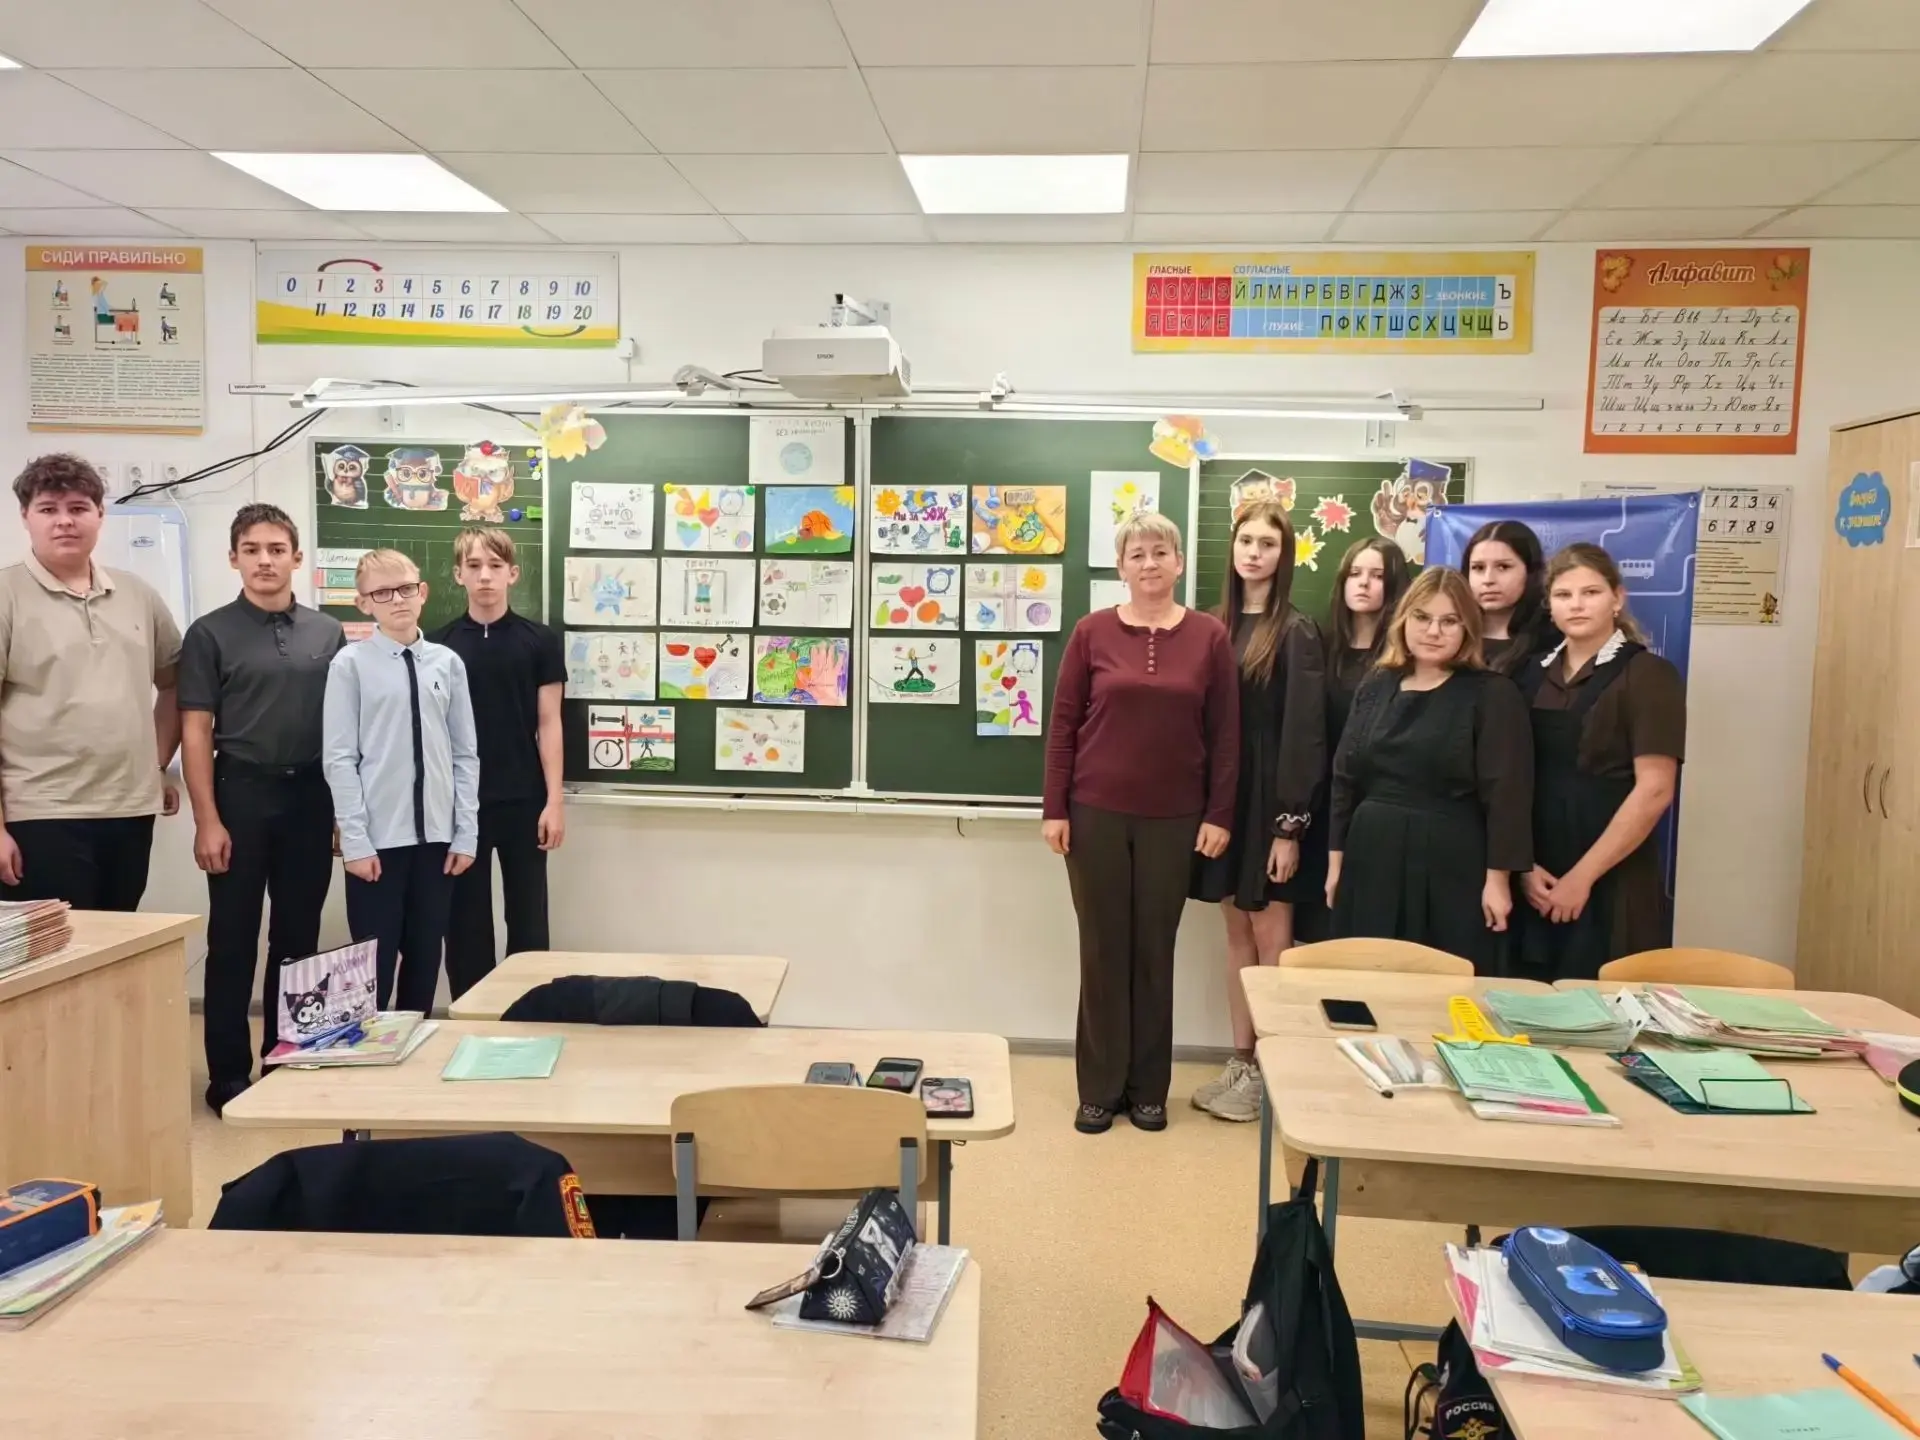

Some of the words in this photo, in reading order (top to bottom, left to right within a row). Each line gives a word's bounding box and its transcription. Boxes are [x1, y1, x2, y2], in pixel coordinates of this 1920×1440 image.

[41, 250, 84, 266] СИДИ
[88, 251, 187, 266] ПРАВИЛЬНО
[1149, 265, 1192, 274] ГЛАСНЫЕ
[1233, 265, 1291, 275] СОГЛАСНЫЕ
[1648, 260, 1755, 288] Алфавит
[286, 278, 297, 292] 0
[317, 279, 323, 293] 1
[346, 279, 355, 293] 2
[374, 279, 384, 293] 3
[403, 279, 413, 294] 4
[432, 280, 442, 295] 5
[461, 280, 470, 295] 6
[490, 280, 499, 295] 7
[520, 280, 529, 295] 8
[549, 280, 558, 296] 9
[575, 280, 591, 296] 10
[315, 303, 326, 317] 11
[343, 303, 357, 317] 12
[371, 304, 386, 318] 13
[401, 304, 415, 318] 14
[430, 304, 444, 318] 15
[459, 304, 474, 319] 16
[488, 305, 502, 319] 17
[518, 305, 532, 320] 18
[546, 305, 561, 320] 19
[573, 305, 592, 320] 20
[1711, 495, 1719, 507] 1
[1729, 495, 1739, 508] 2
[1748, 496, 1758, 508] 3
[1768, 496, 1777, 508] 4
[922, 506, 948, 521] ЗОЖ
[1708, 520, 1717, 532] 6
[1728, 520, 1738, 532] 7
[1746, 520, 1757, 533] 8
[1764, 521, 1774, 533] 9
[1446, 1401, 1495, 1421] РОССИЯ
